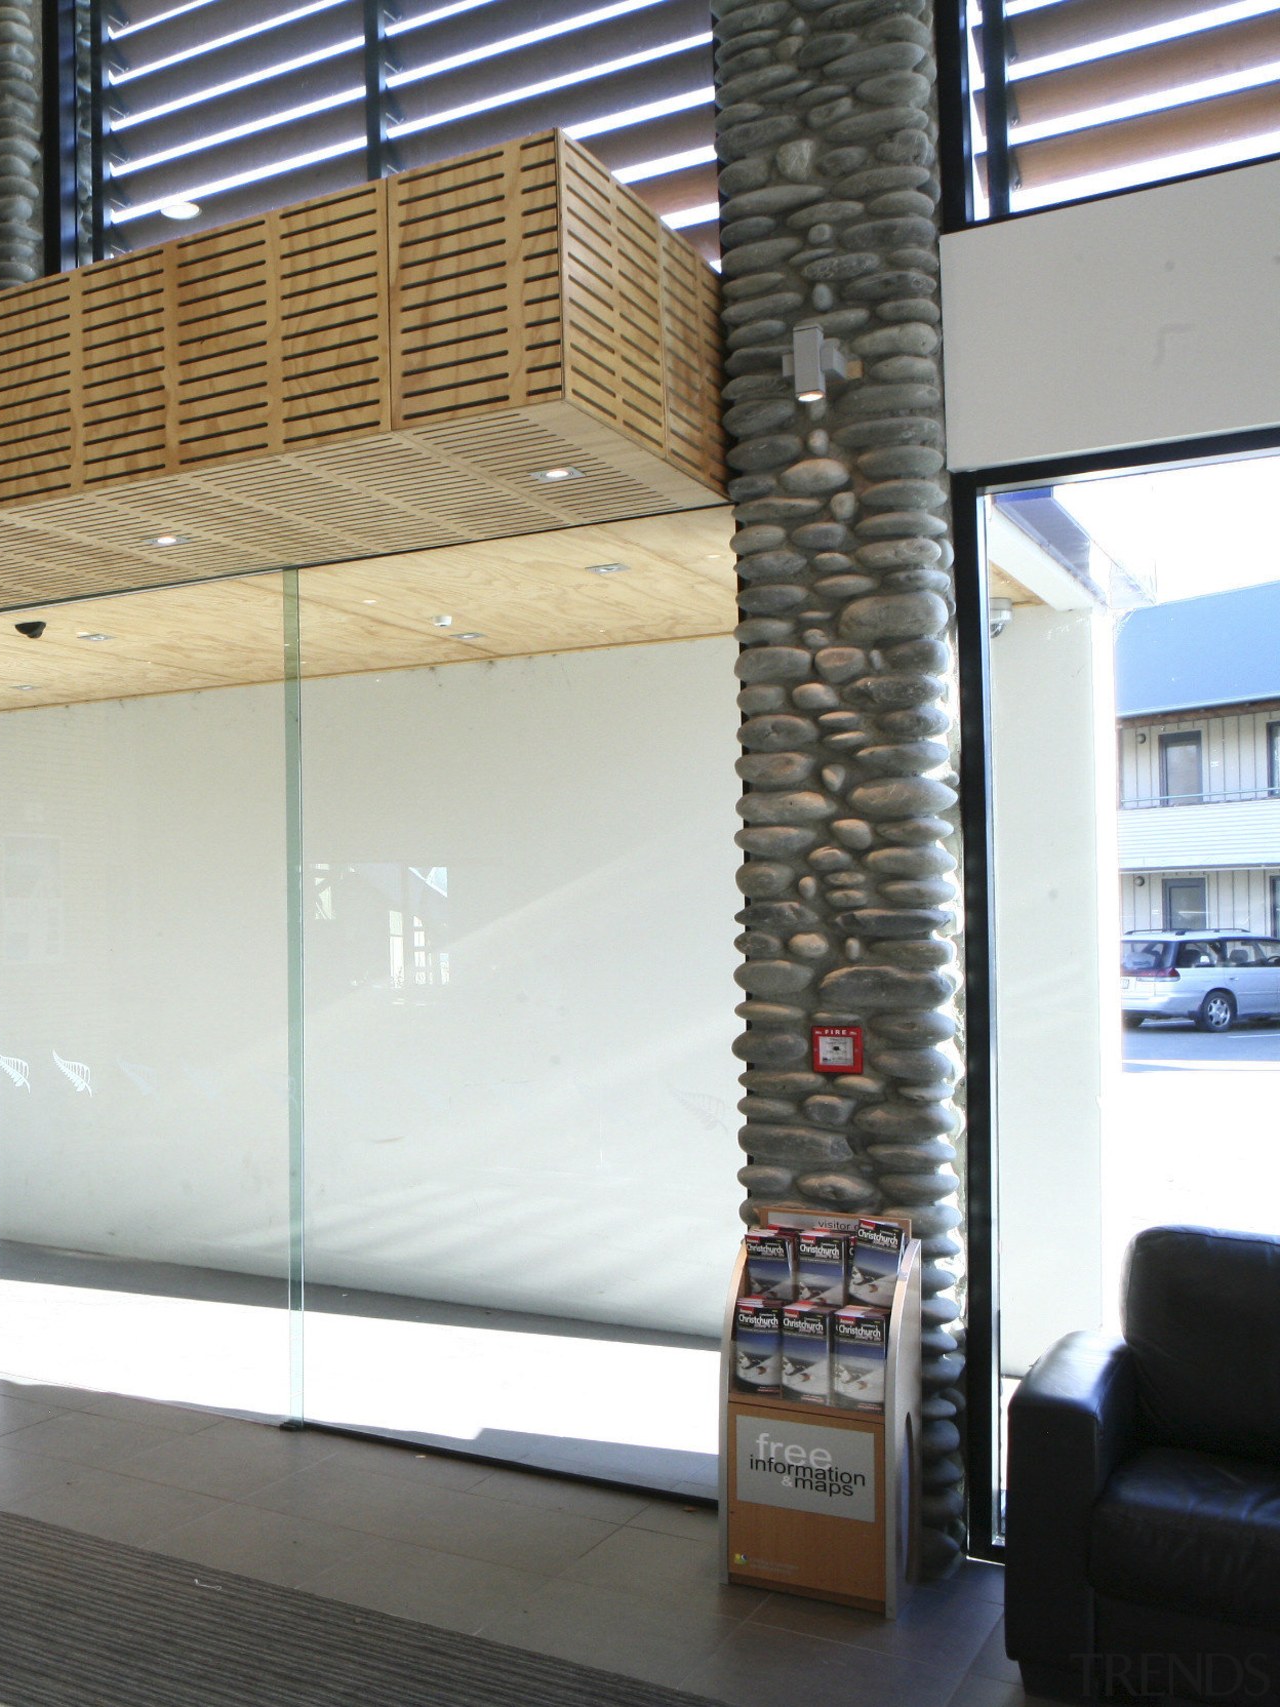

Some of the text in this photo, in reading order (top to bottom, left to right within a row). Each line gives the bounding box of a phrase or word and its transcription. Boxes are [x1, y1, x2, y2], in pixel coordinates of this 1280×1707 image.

[817, 1220, 851, 1231] visitor
[857, 1228, 898, 1246] Christchurch
[747, 1243, 785, 1255] Christchurch
[800, 1243, 840, 1256] Christchurch
[738, 1313, 779, 1326] Christchurch
[783, 1317, 824, 1331] Christchurch
[839, 1324, 881, 1338] Christchurch
[755, 1432, 833, 1470] free
[749, 1454, 866, 1487] information
